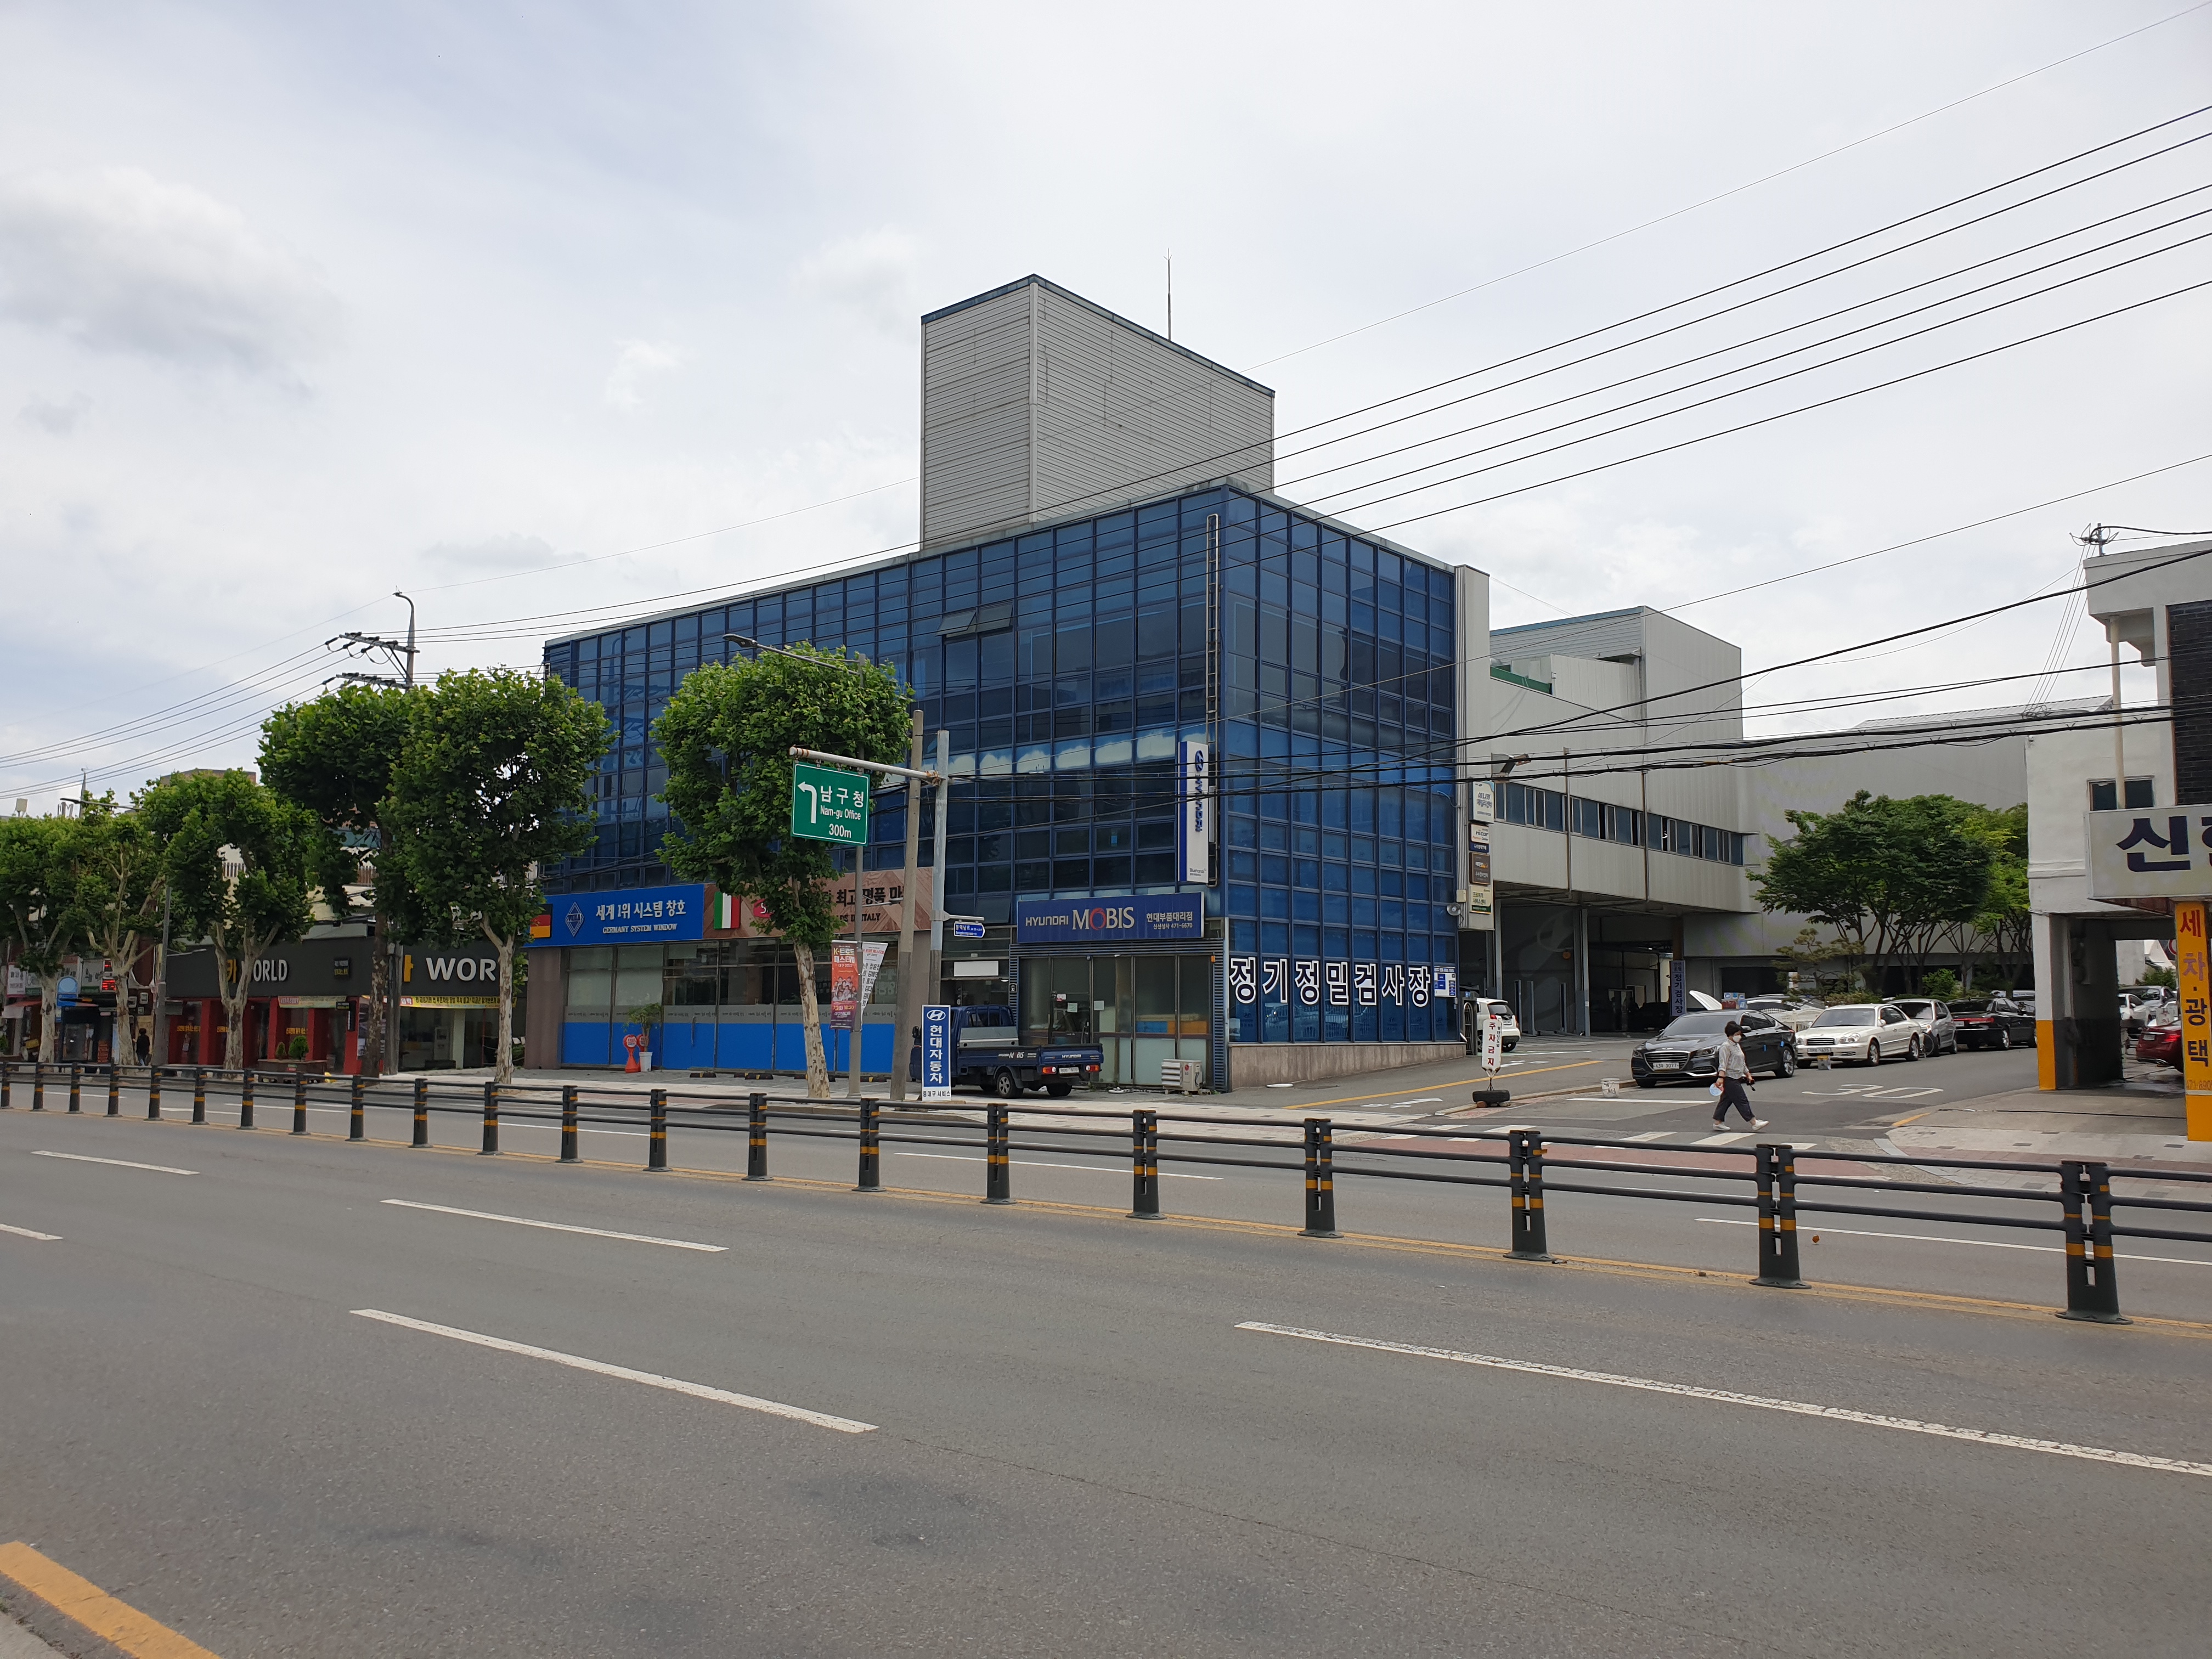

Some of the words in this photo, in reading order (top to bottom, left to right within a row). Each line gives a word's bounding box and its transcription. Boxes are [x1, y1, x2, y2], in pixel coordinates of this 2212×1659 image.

[820, 785, 864, 808] 남구청
[1195, 774, 1203, 832] HYNDAI
[820, 805, 843, 819] Nam-gu
[844, 808, 861, 820] Office
[828, 823, 851, 838] 300m
[2116, 815, 2212, 872] 신
[862, 887, 886, 905] 명품
[596, 904, 615, 921] 세계
[633, 901, 663, 918] 시스템
[666, 899, 686, 917] 창호
[861, 913, 881, 922] ITALY
[1025, 916, 1069, 927] HYUNDAI
[1072, 906, 1135, 930] MOBIS
[1146, 911, 1193, 923] 현대부품대리점
[603, 926, 629, 934] GERMANY
[630, 924, 652, 933] SYSTEM
[242, 959, 288, 982] ORLD
[426, 957, 496, 981] WOR
[1229, 957, 1431, 1007] 정기정밀검사장
[1674, 974, 1683, 1014] 정기검사장
[929, 1025, 943, 1084] 현대자동차
